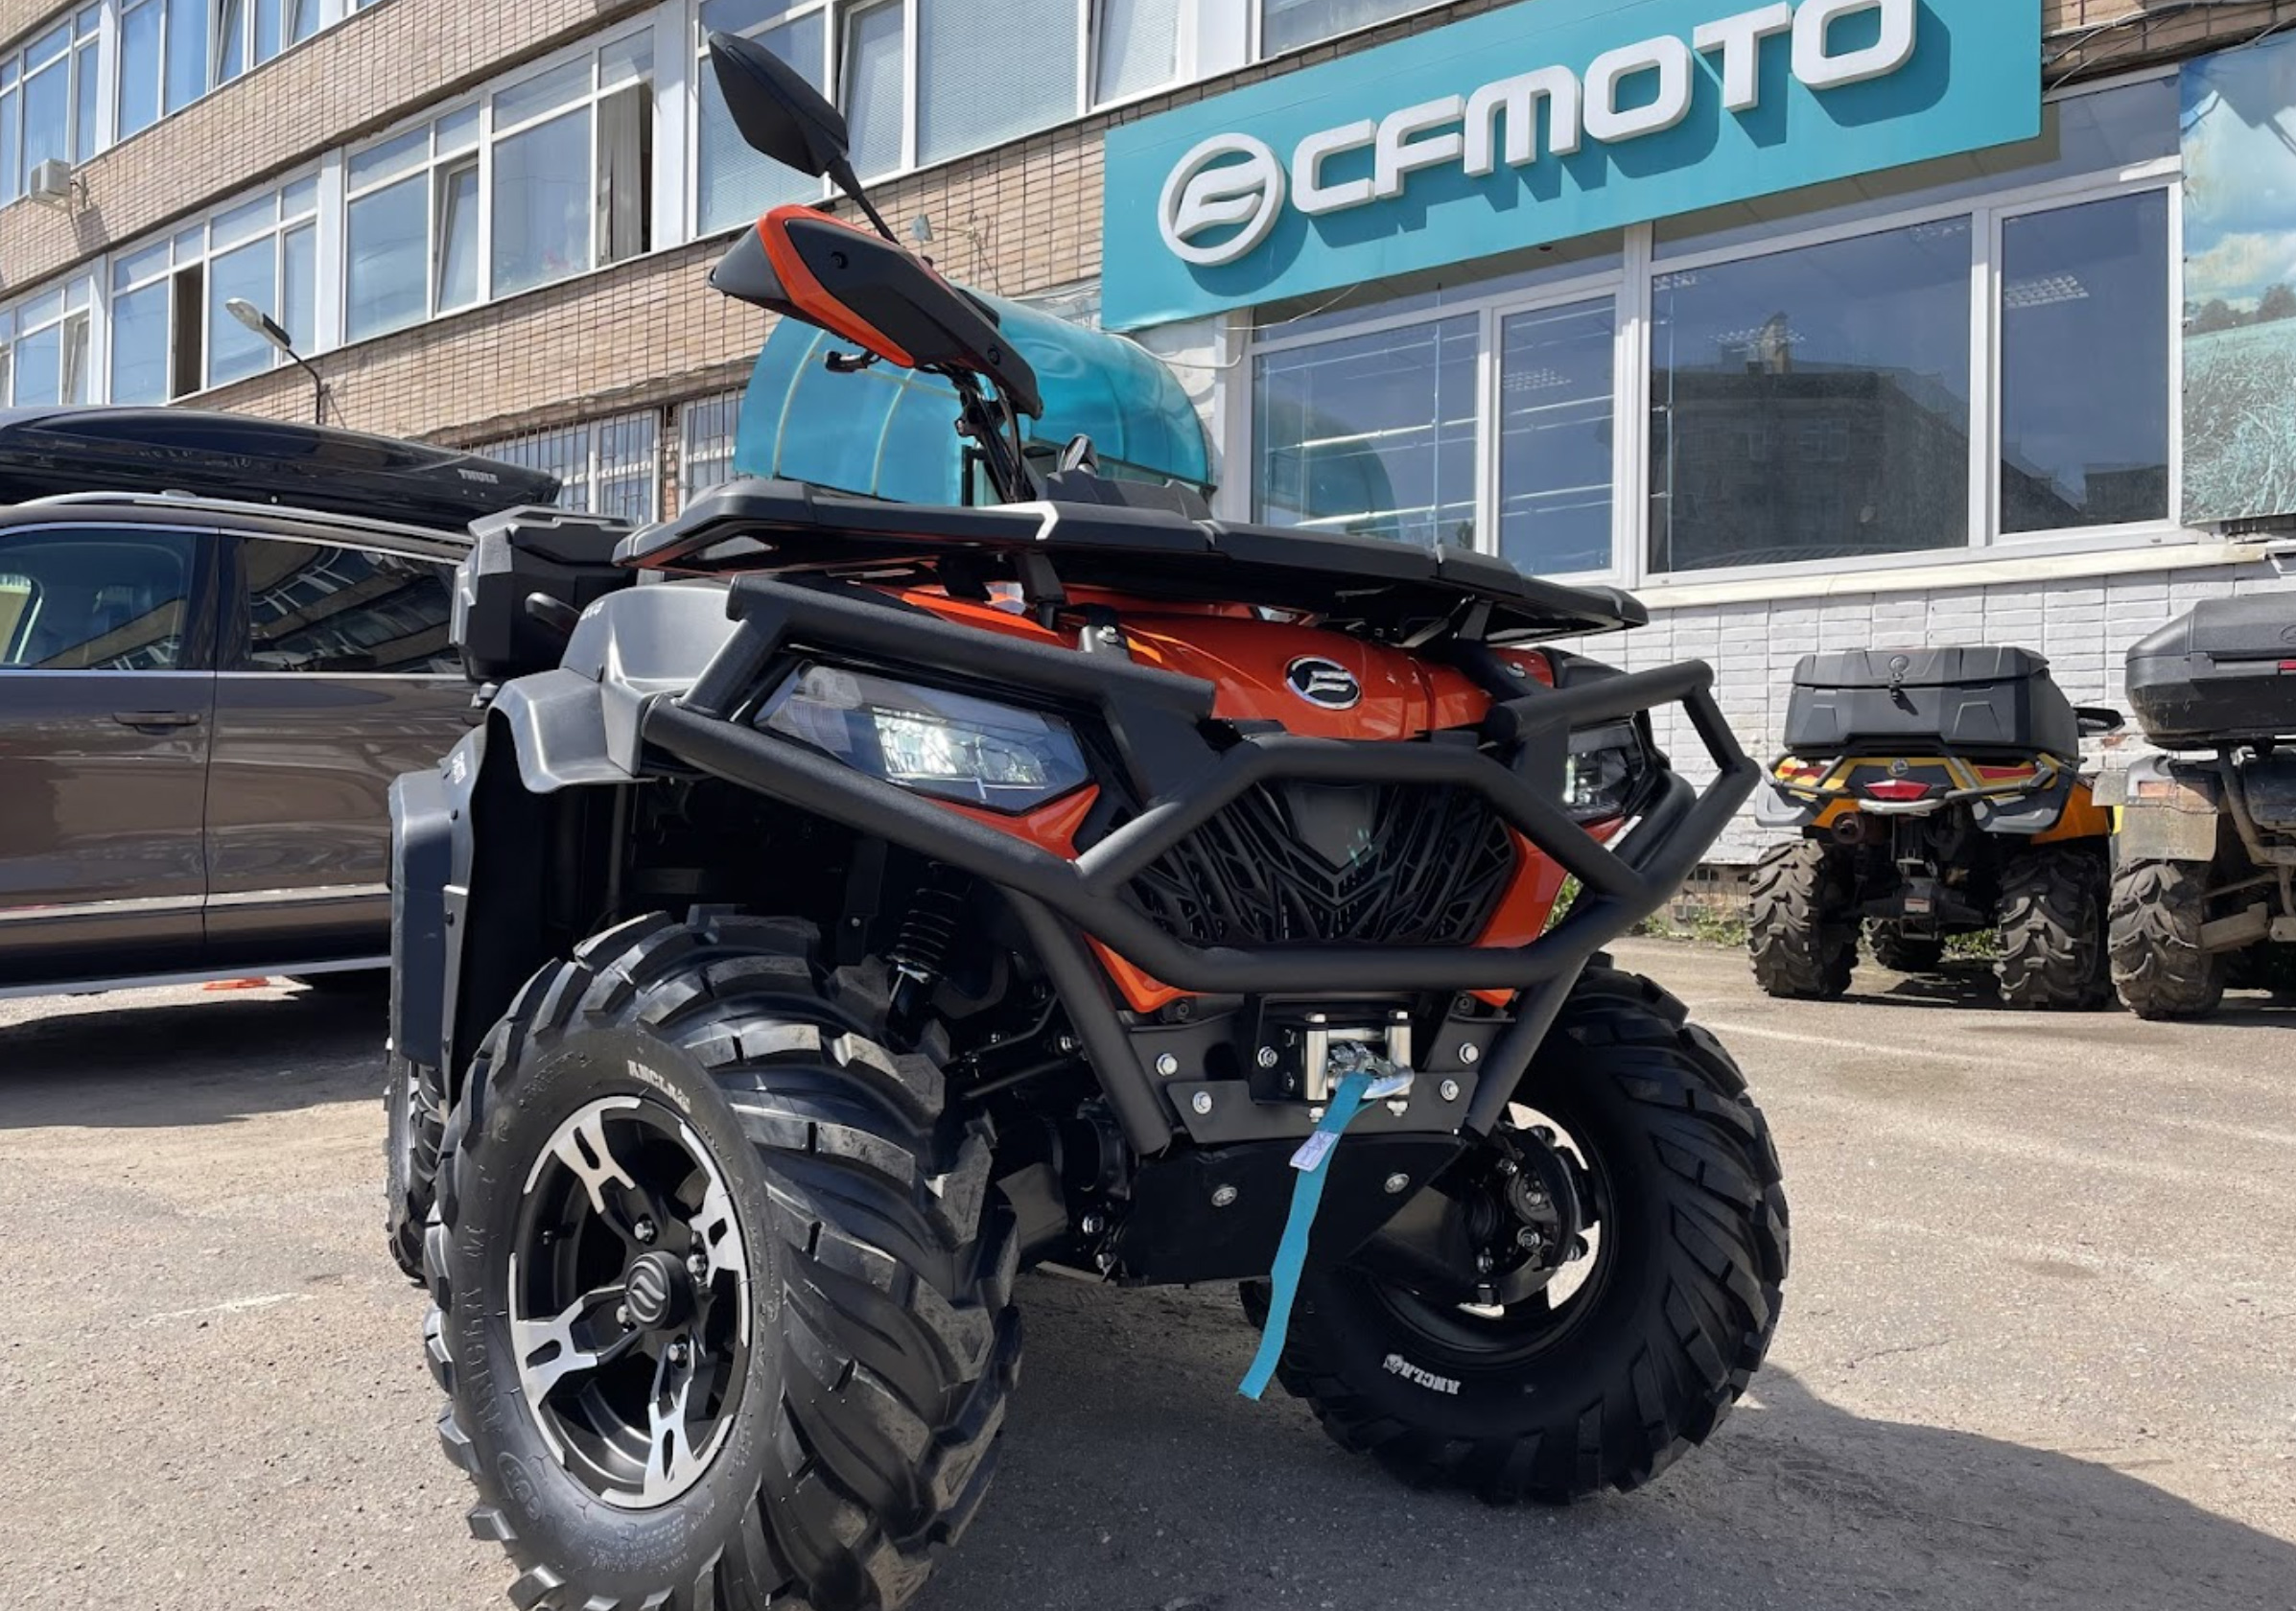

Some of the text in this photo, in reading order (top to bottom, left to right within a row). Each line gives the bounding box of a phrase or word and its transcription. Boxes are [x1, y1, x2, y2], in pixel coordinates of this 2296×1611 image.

[1292, 0, 1917, 216] CFMOTO
[457, 468, 499, 484] THULE
[1399, 1361, 1461, 1395] ANCLA
